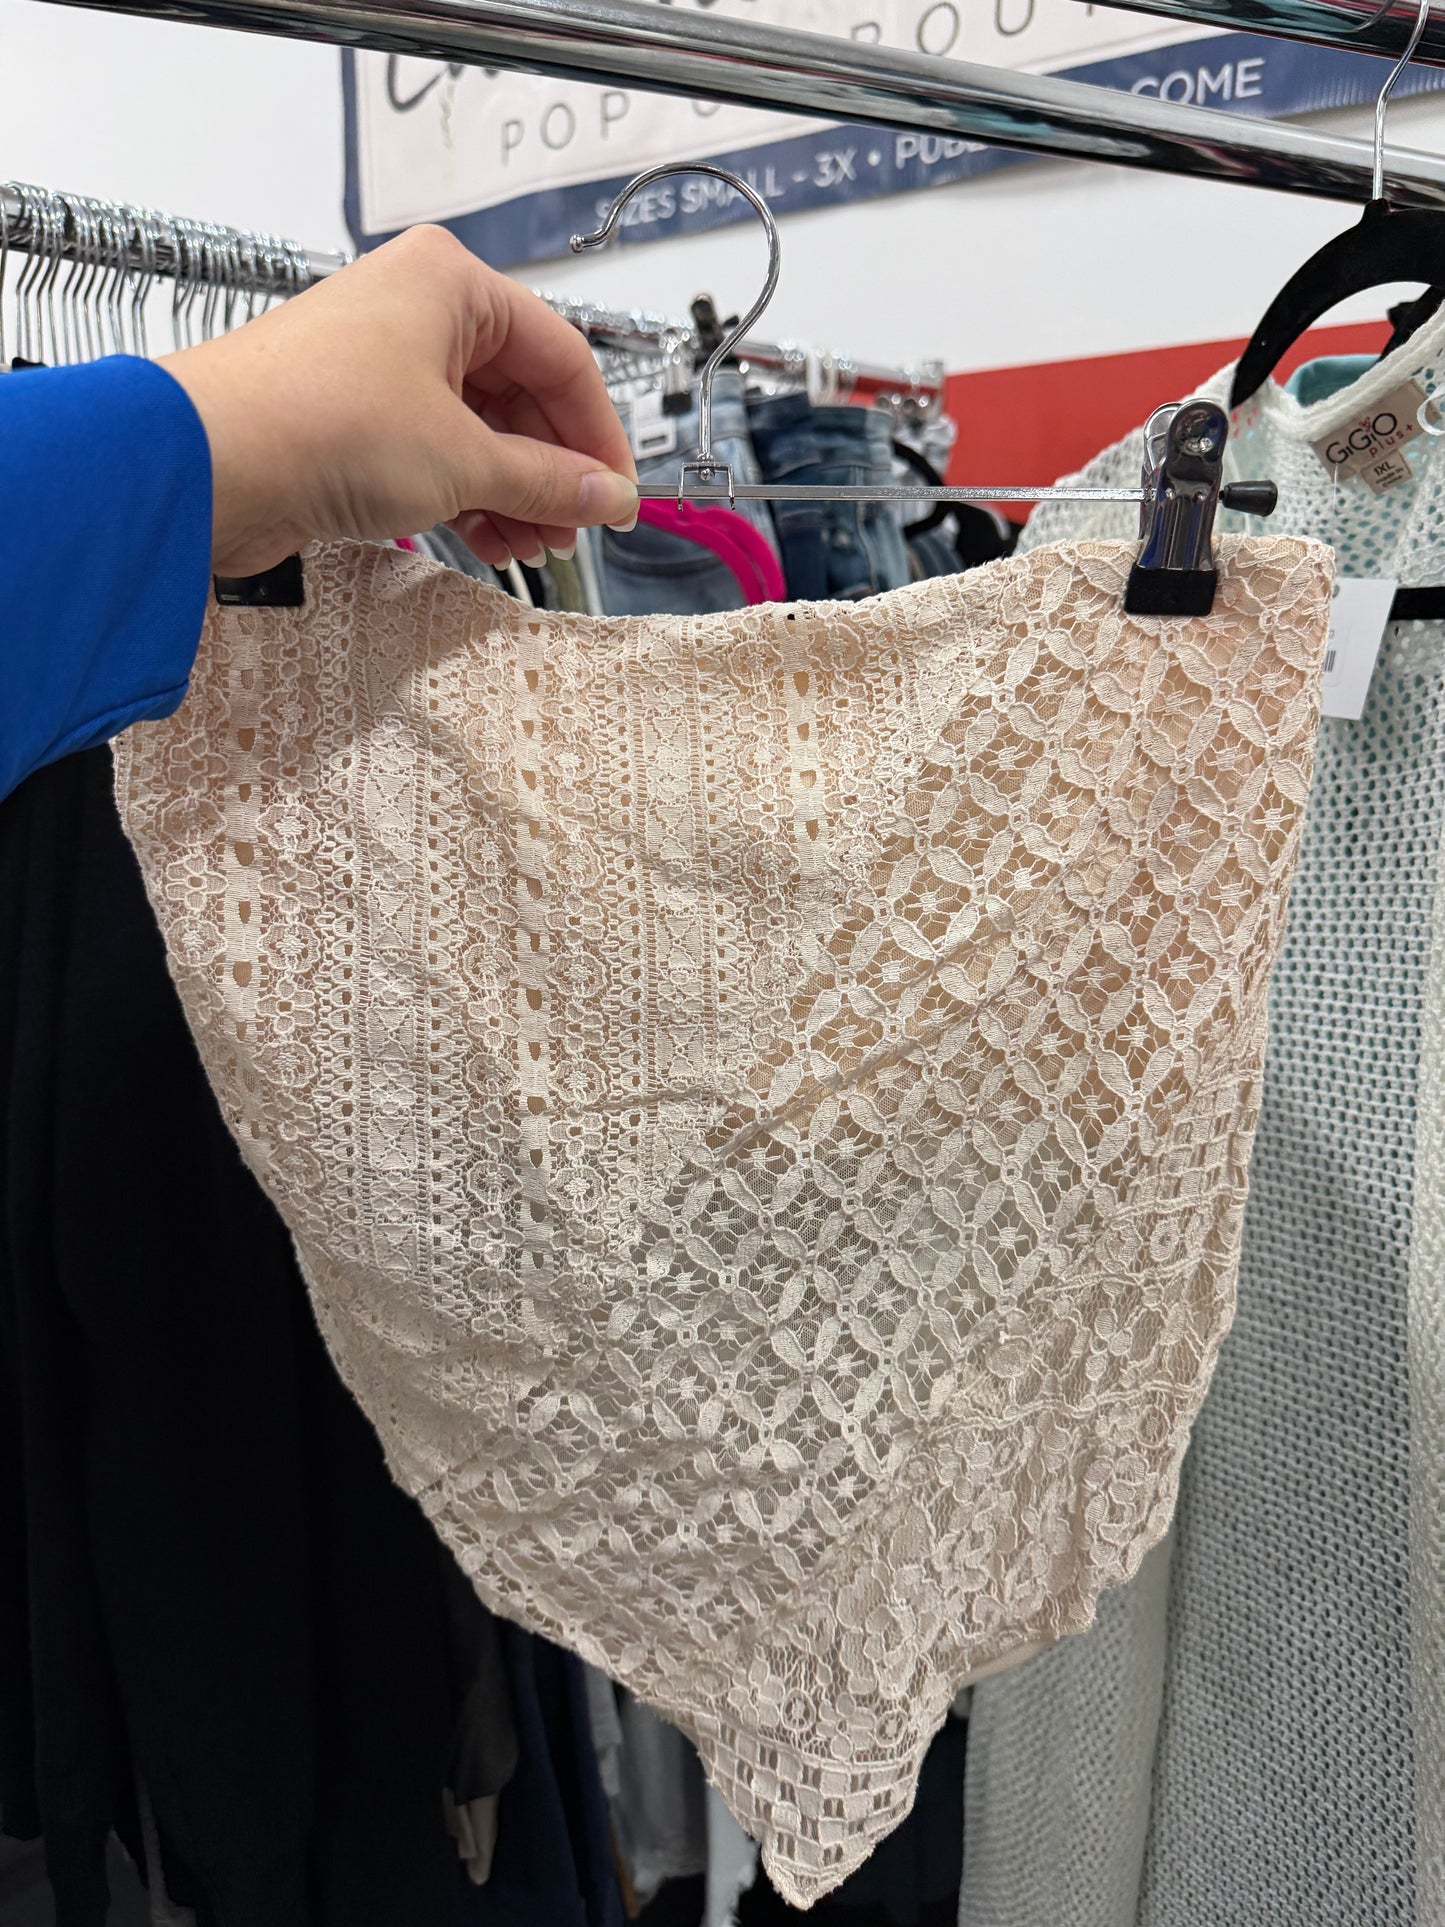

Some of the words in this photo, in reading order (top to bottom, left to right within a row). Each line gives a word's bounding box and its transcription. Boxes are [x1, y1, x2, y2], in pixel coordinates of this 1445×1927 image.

[501, 91, 630, 165] POP
[813, 149, 857, 187] 3X
[1373, 461, 1396, 476] 1XL
